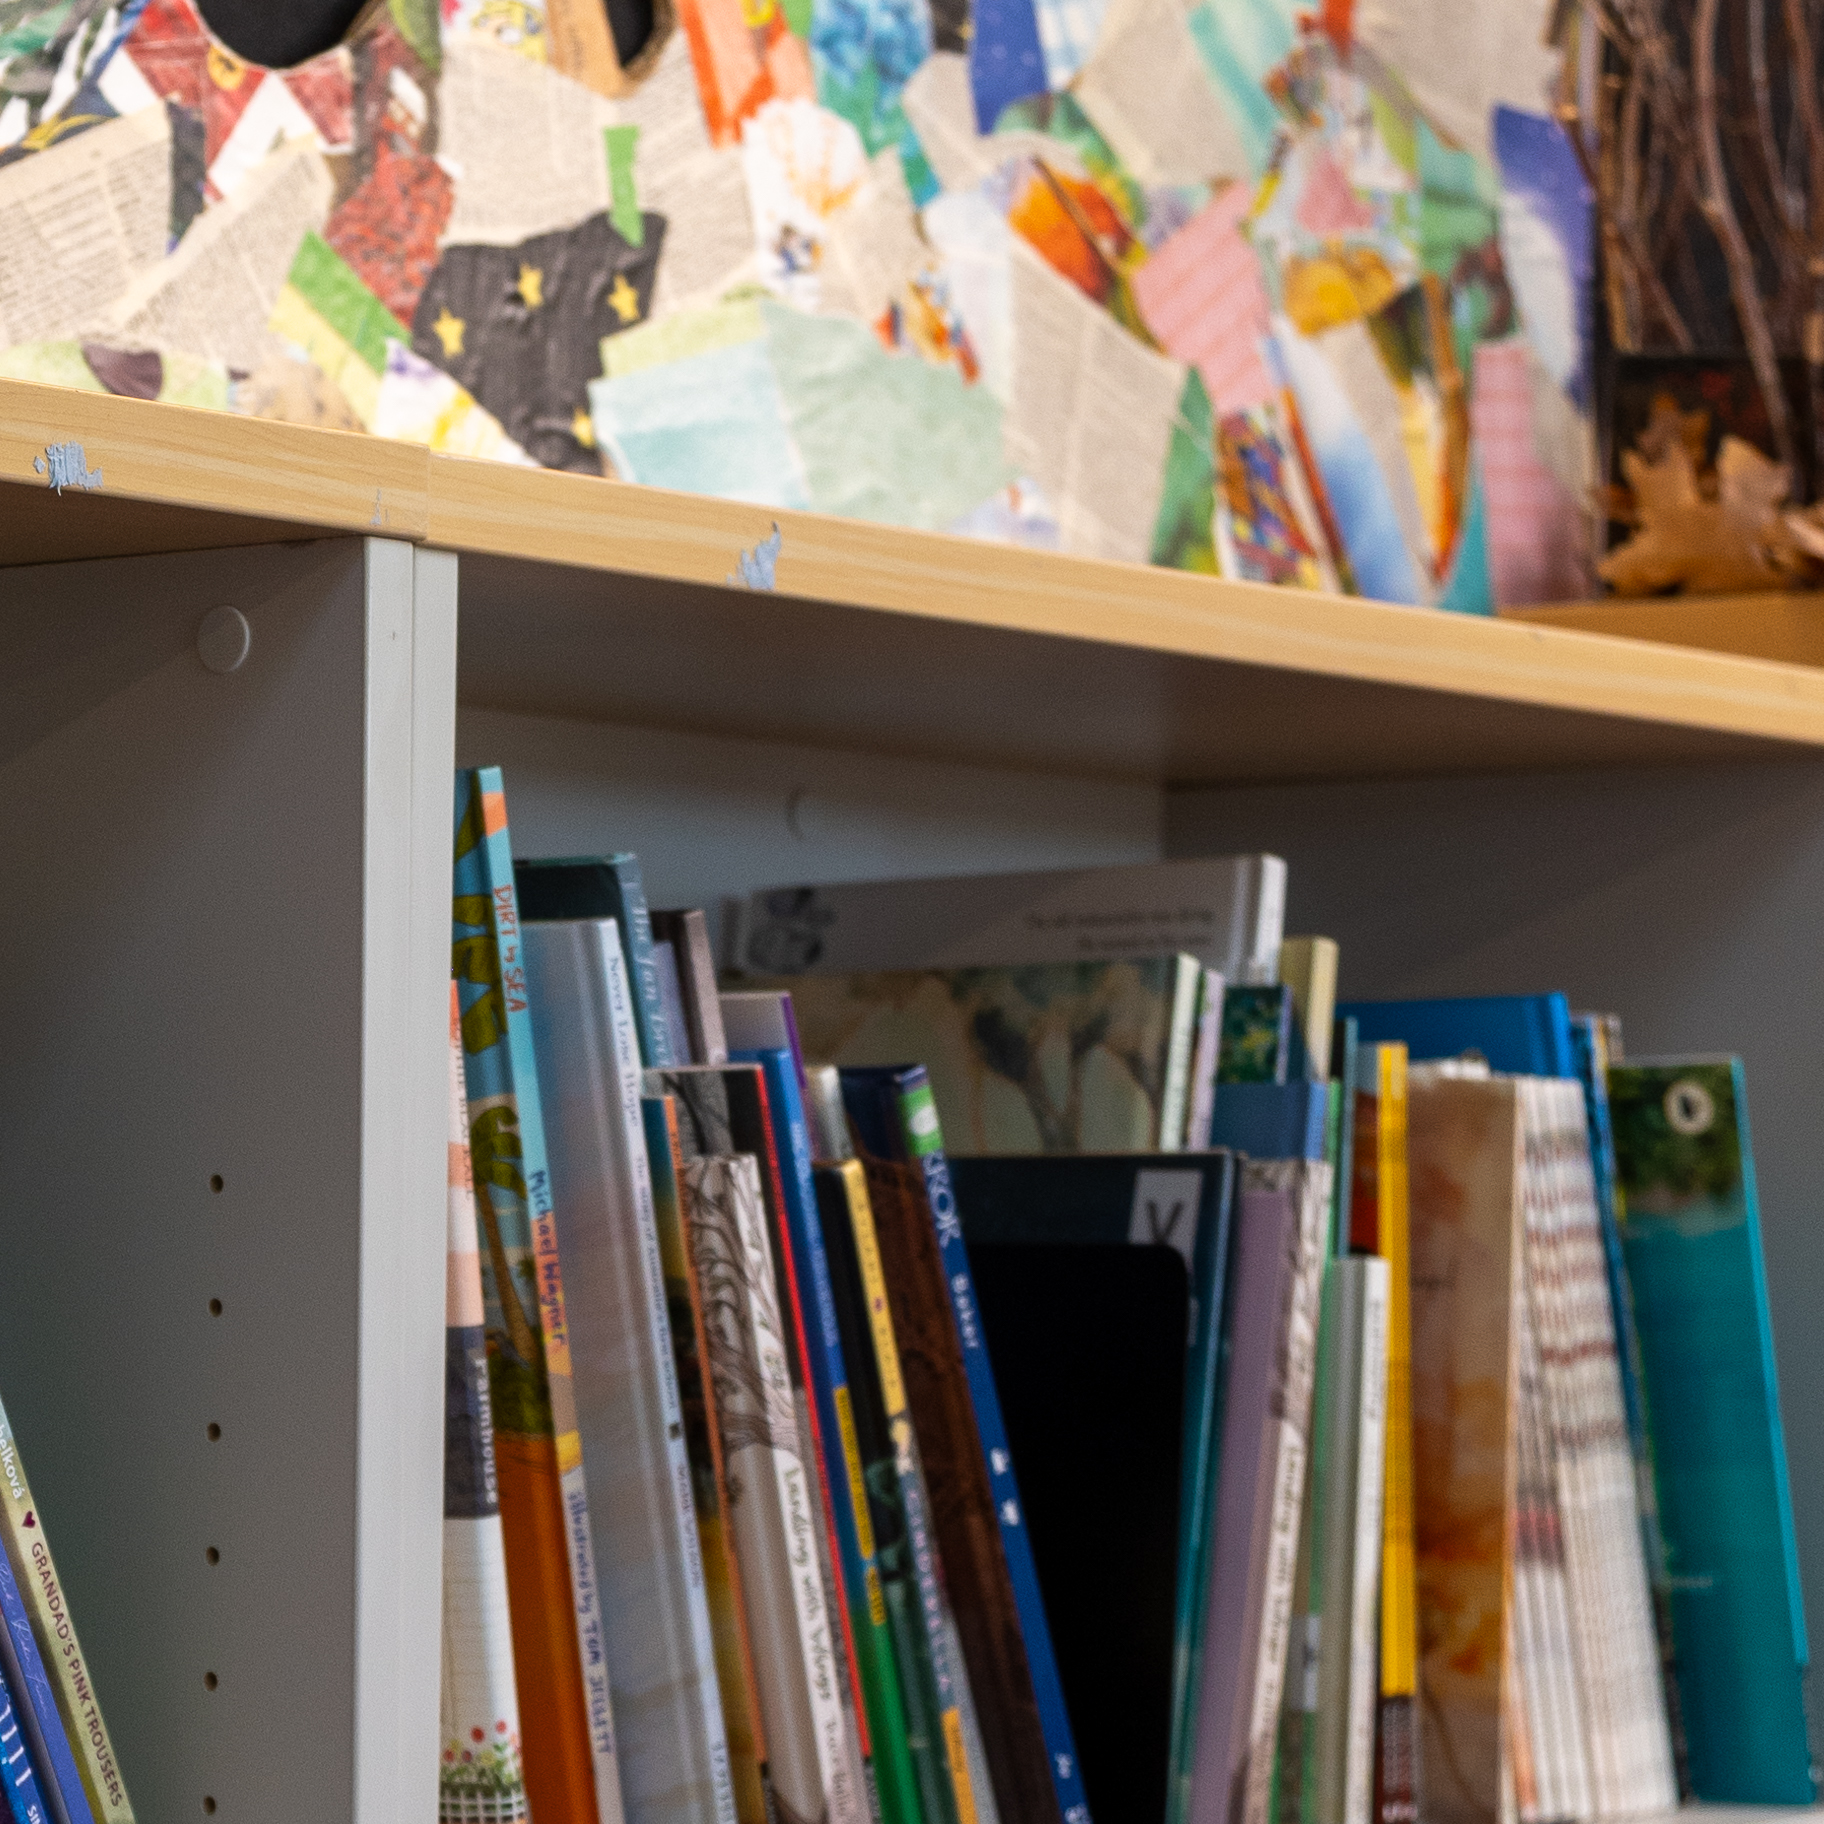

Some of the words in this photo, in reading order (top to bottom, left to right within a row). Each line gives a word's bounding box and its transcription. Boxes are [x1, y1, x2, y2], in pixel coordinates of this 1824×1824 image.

[529, 1168, 557, 1257] Michael
[540, 1262, 567, 1346] Wagner
[30, 1541, 77, 1667] GRANDAD'S
[67, 1659, 90, 1706] PINK
[81, 1702, 126, 1809] TROUSERS
